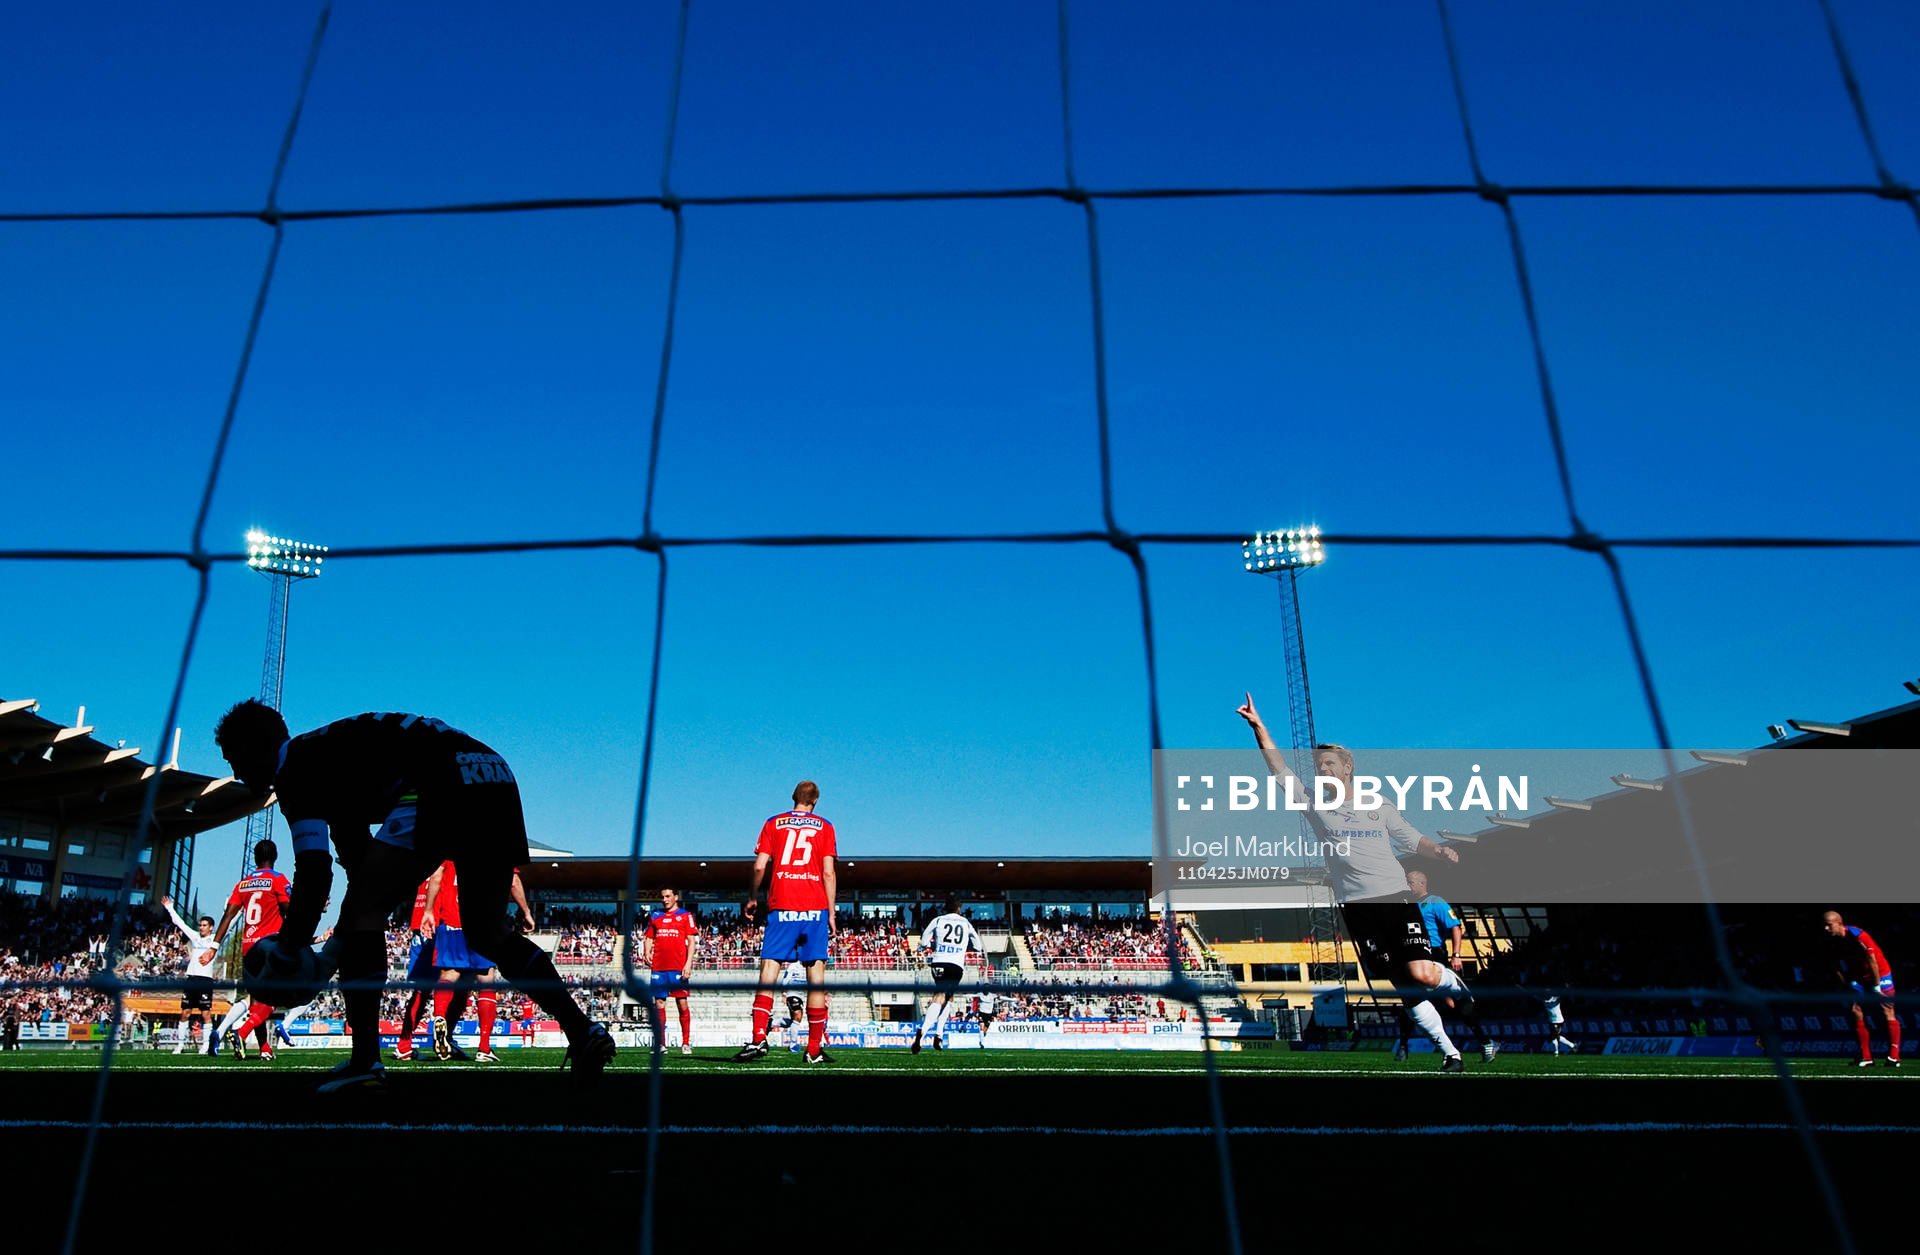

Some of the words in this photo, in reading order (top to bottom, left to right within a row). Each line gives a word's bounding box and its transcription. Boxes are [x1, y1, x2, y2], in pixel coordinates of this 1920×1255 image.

[781, 828, 817, 866] 15
[25, 862, 45, 877] NA
[246, 891, 262, 925] 6
[778, 910, 821, 922] KRAFT
[943, 923, 963, 944] 29
[1153, 1024, 1182, 1035] pahl
[1611, 1038, 1672, 1054] DEMCOM
